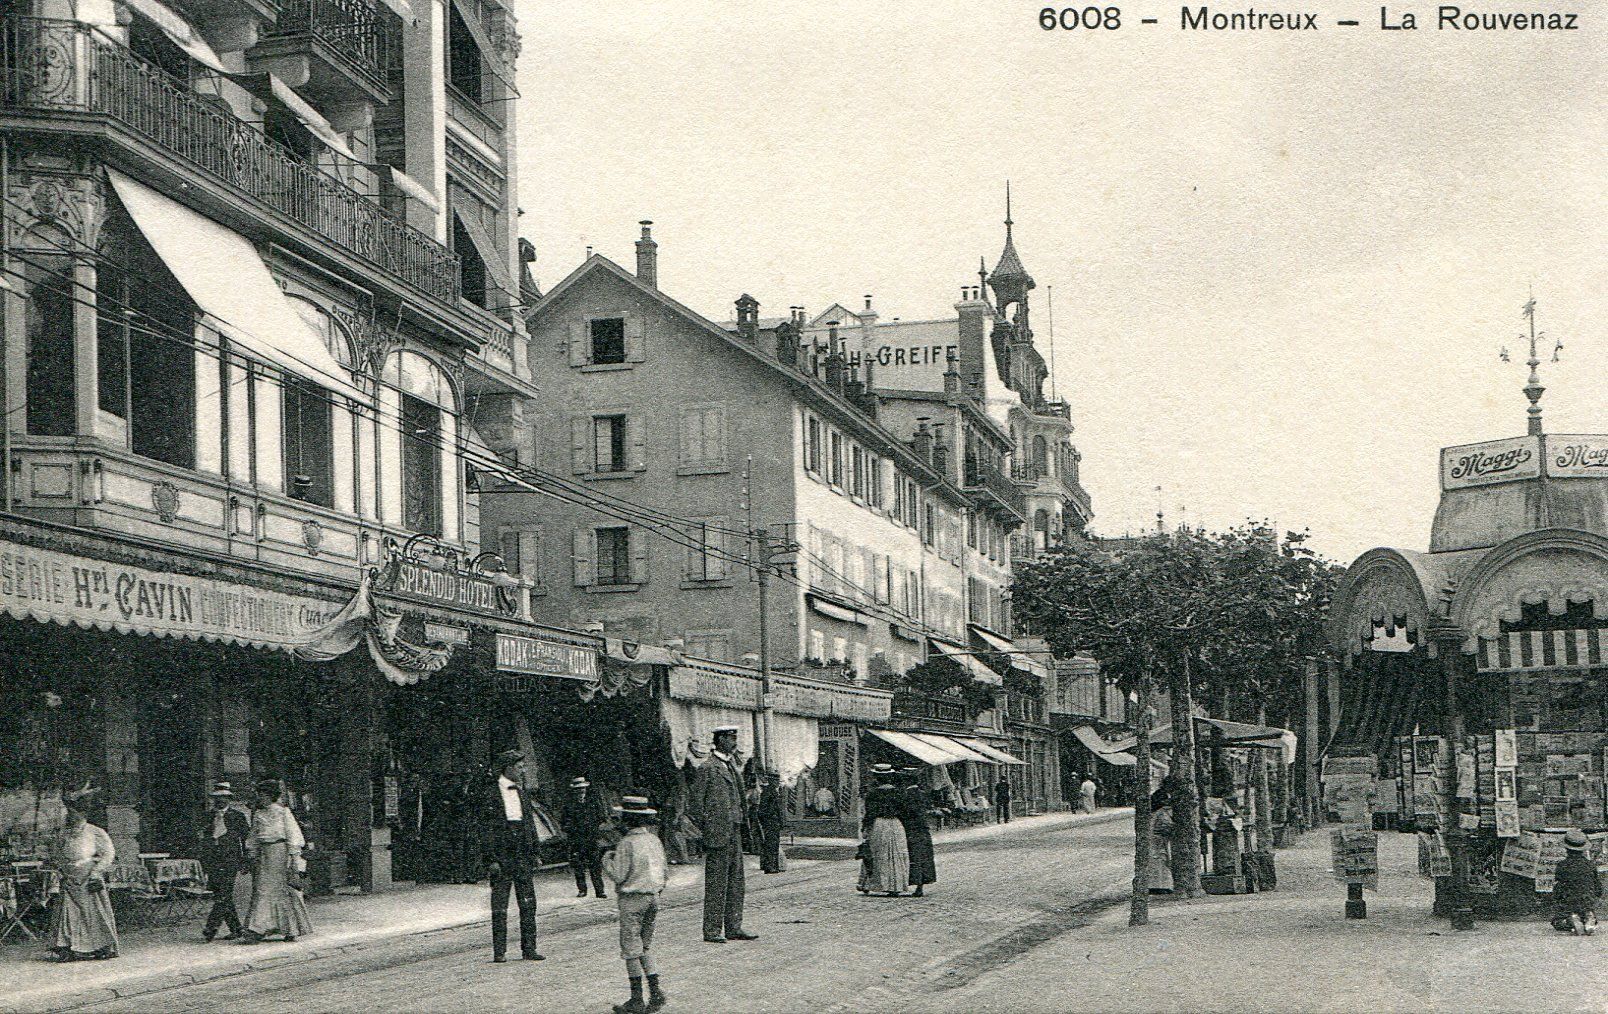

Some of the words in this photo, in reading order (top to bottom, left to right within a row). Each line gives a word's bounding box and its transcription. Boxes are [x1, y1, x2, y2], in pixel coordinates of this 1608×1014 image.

[1451, 445, 1532, 479] Maggi
[1556, 444, 1608, 468] Mag
[400, 564, 456, 601] SPLENDID
[459, 577, 495, 610] HOTEL
[497, 638, 528, 669] KODAK
[568, 649, 597, 678] KODAK
